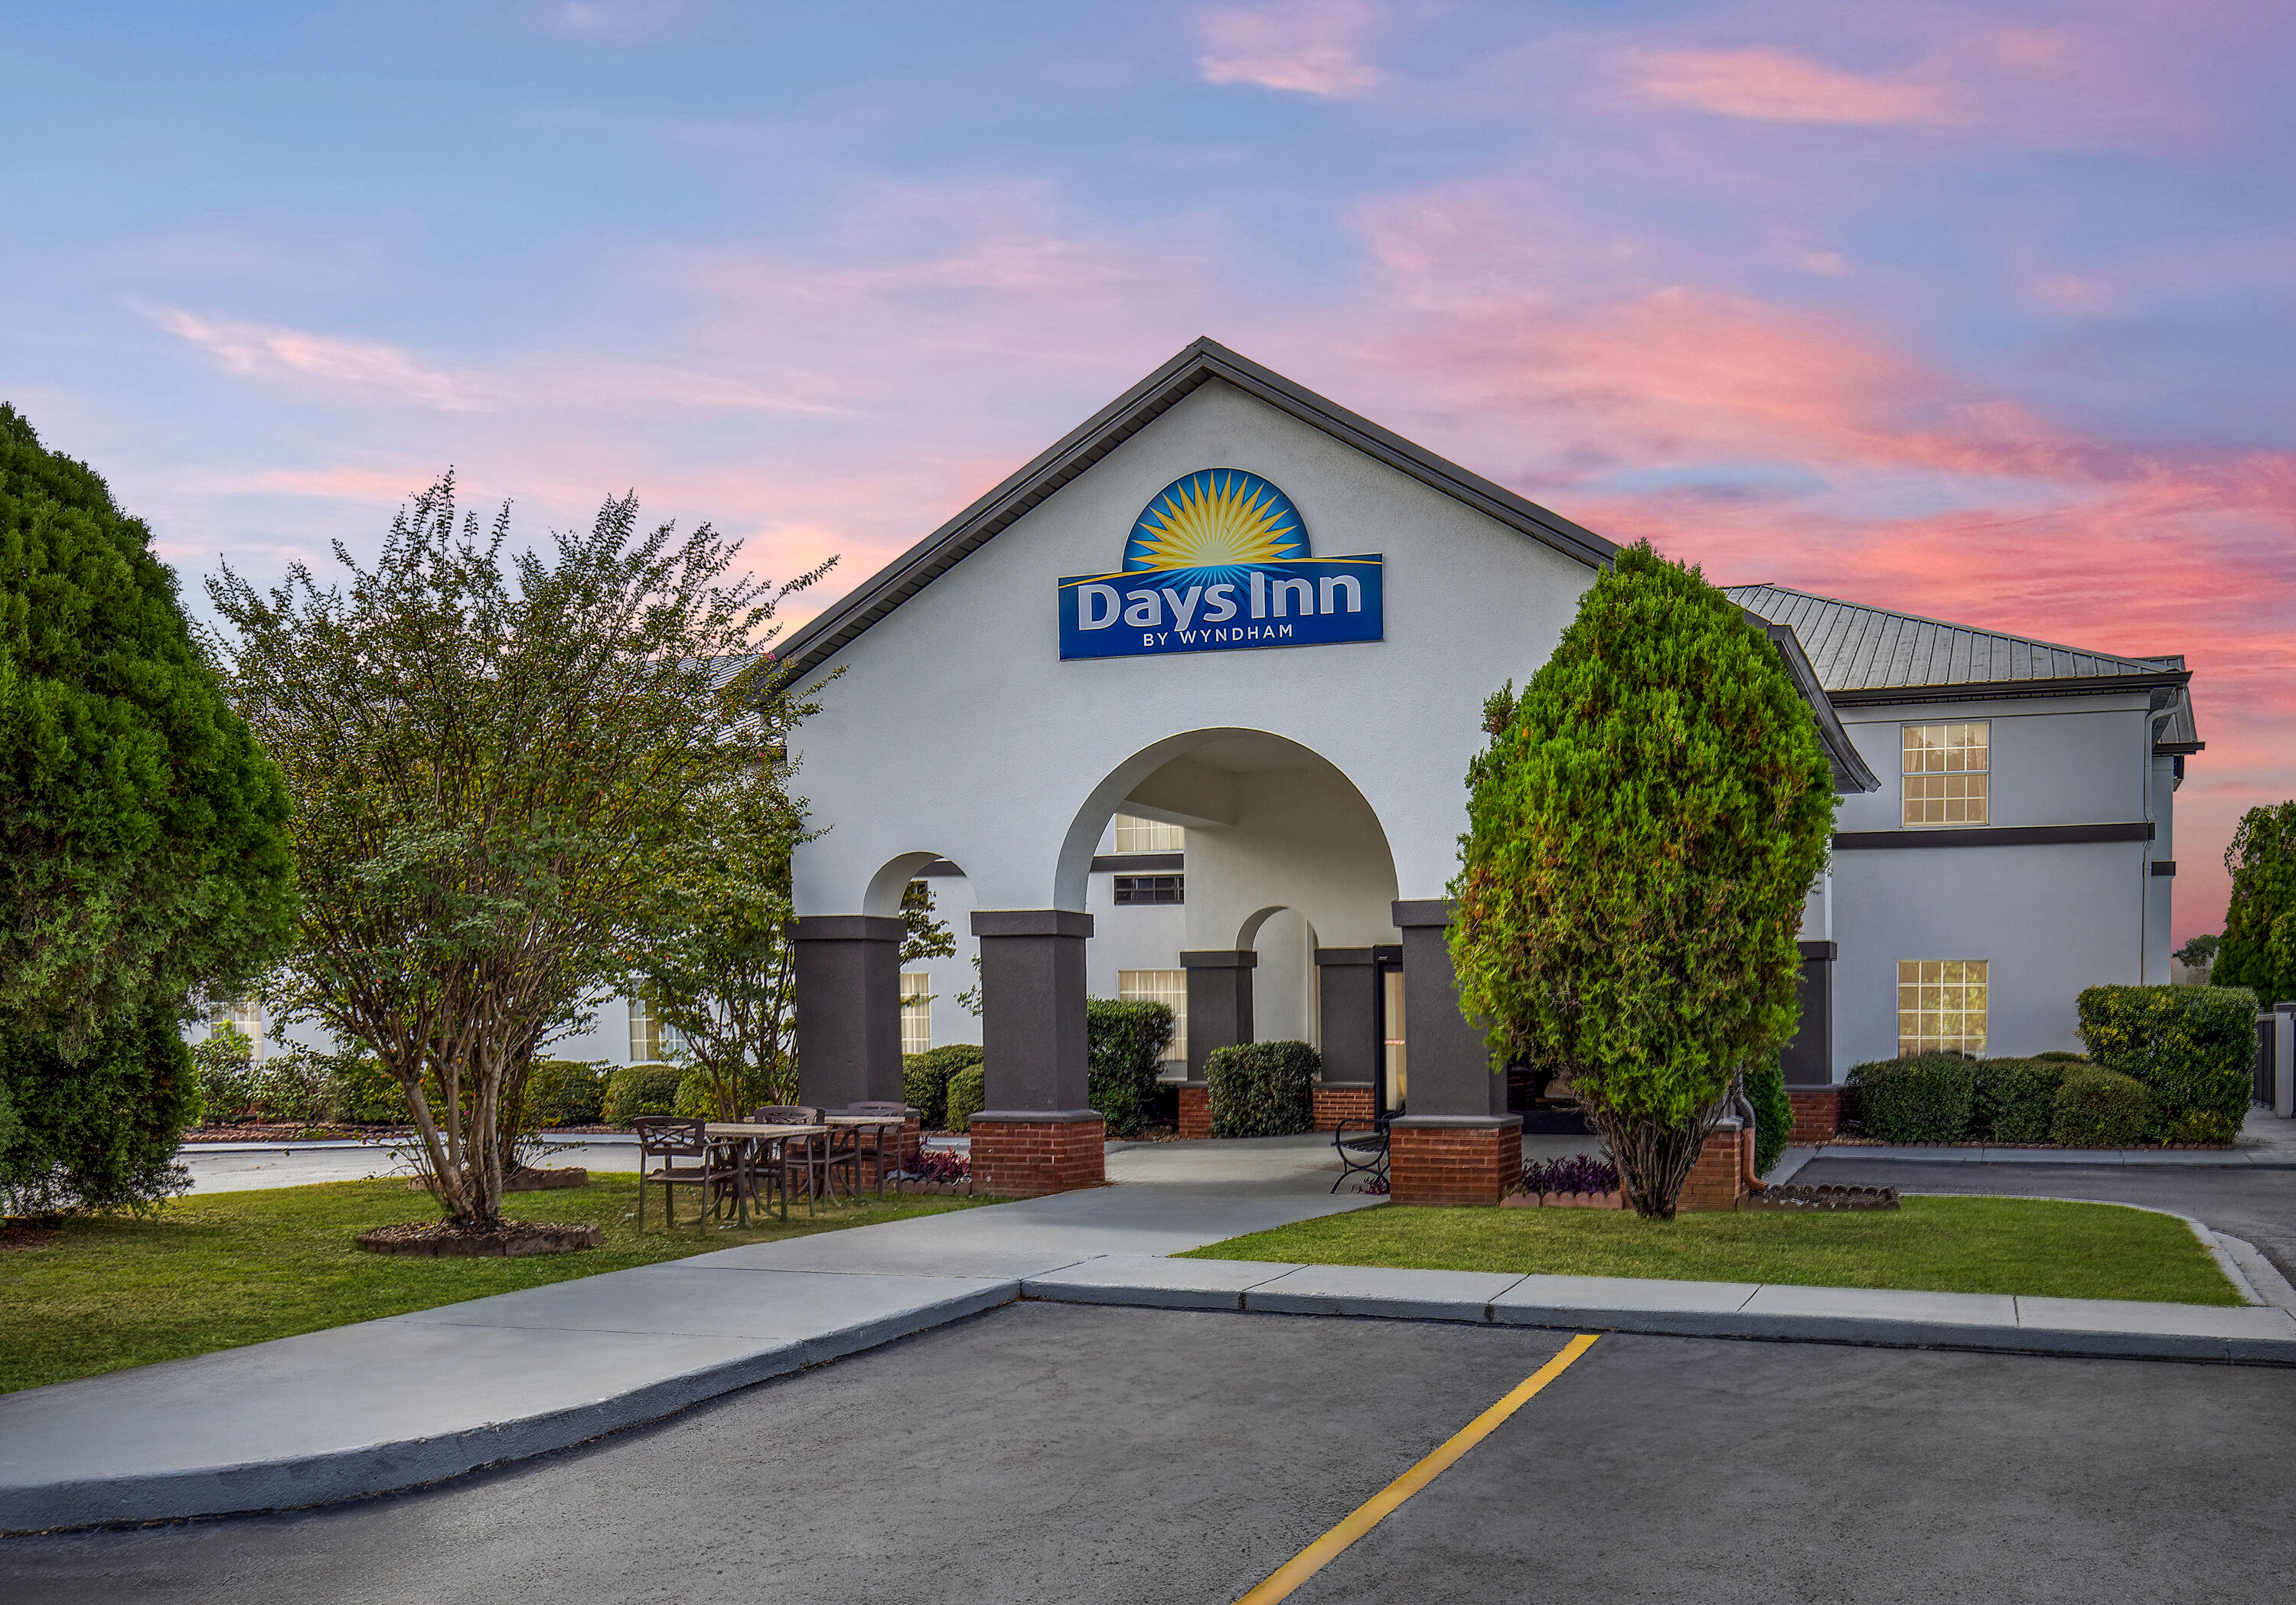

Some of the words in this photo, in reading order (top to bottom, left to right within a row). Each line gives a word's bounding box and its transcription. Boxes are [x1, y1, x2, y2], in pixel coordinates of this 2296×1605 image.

[1078, 583, 1238, 632] Days
[1250, 572, 1362, 619] Inn
[1143, 632, 1169, 647] BY
[1179, 624, 1293, 644] WYNDHAM
